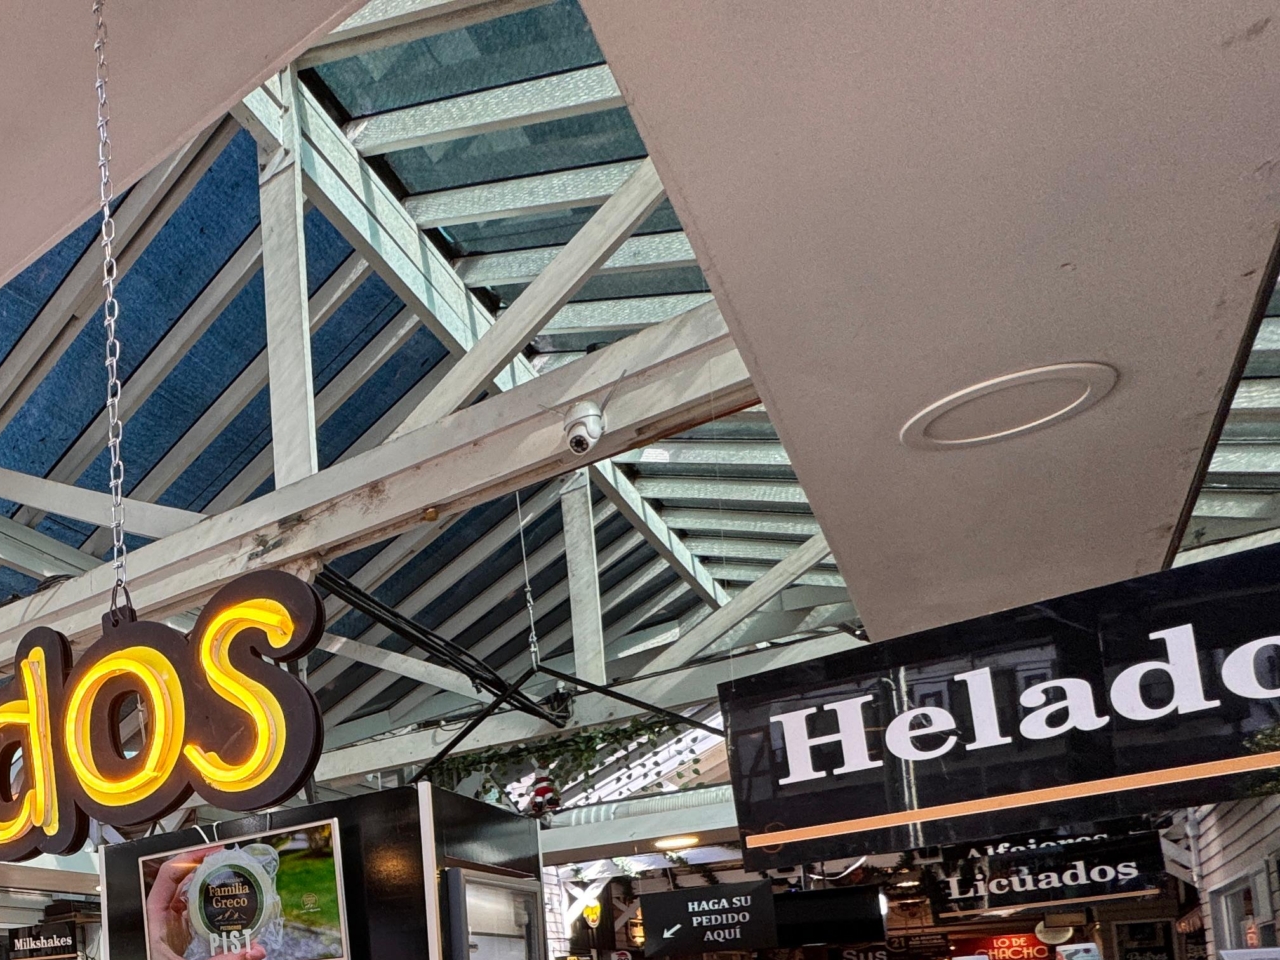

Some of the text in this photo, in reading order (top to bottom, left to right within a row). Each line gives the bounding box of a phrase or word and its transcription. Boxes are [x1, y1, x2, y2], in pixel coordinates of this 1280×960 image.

[770, 623, 1280, 786] Helado
[945, 860, 1139, 900] Licuados
[208, 884, 250, 897] Familia
[212, 896, 248, 909] Greco
[688, 895, 752, 913] HAGA SU
[692, 912, 750, 927] PEDIDO
[14, 934, 73, 951] Milkshakes
[209, 928, 253, 956] PIST
[703, 925, 741, 943] AQUÍ
[993, 937, 1028, 948] LO DE
